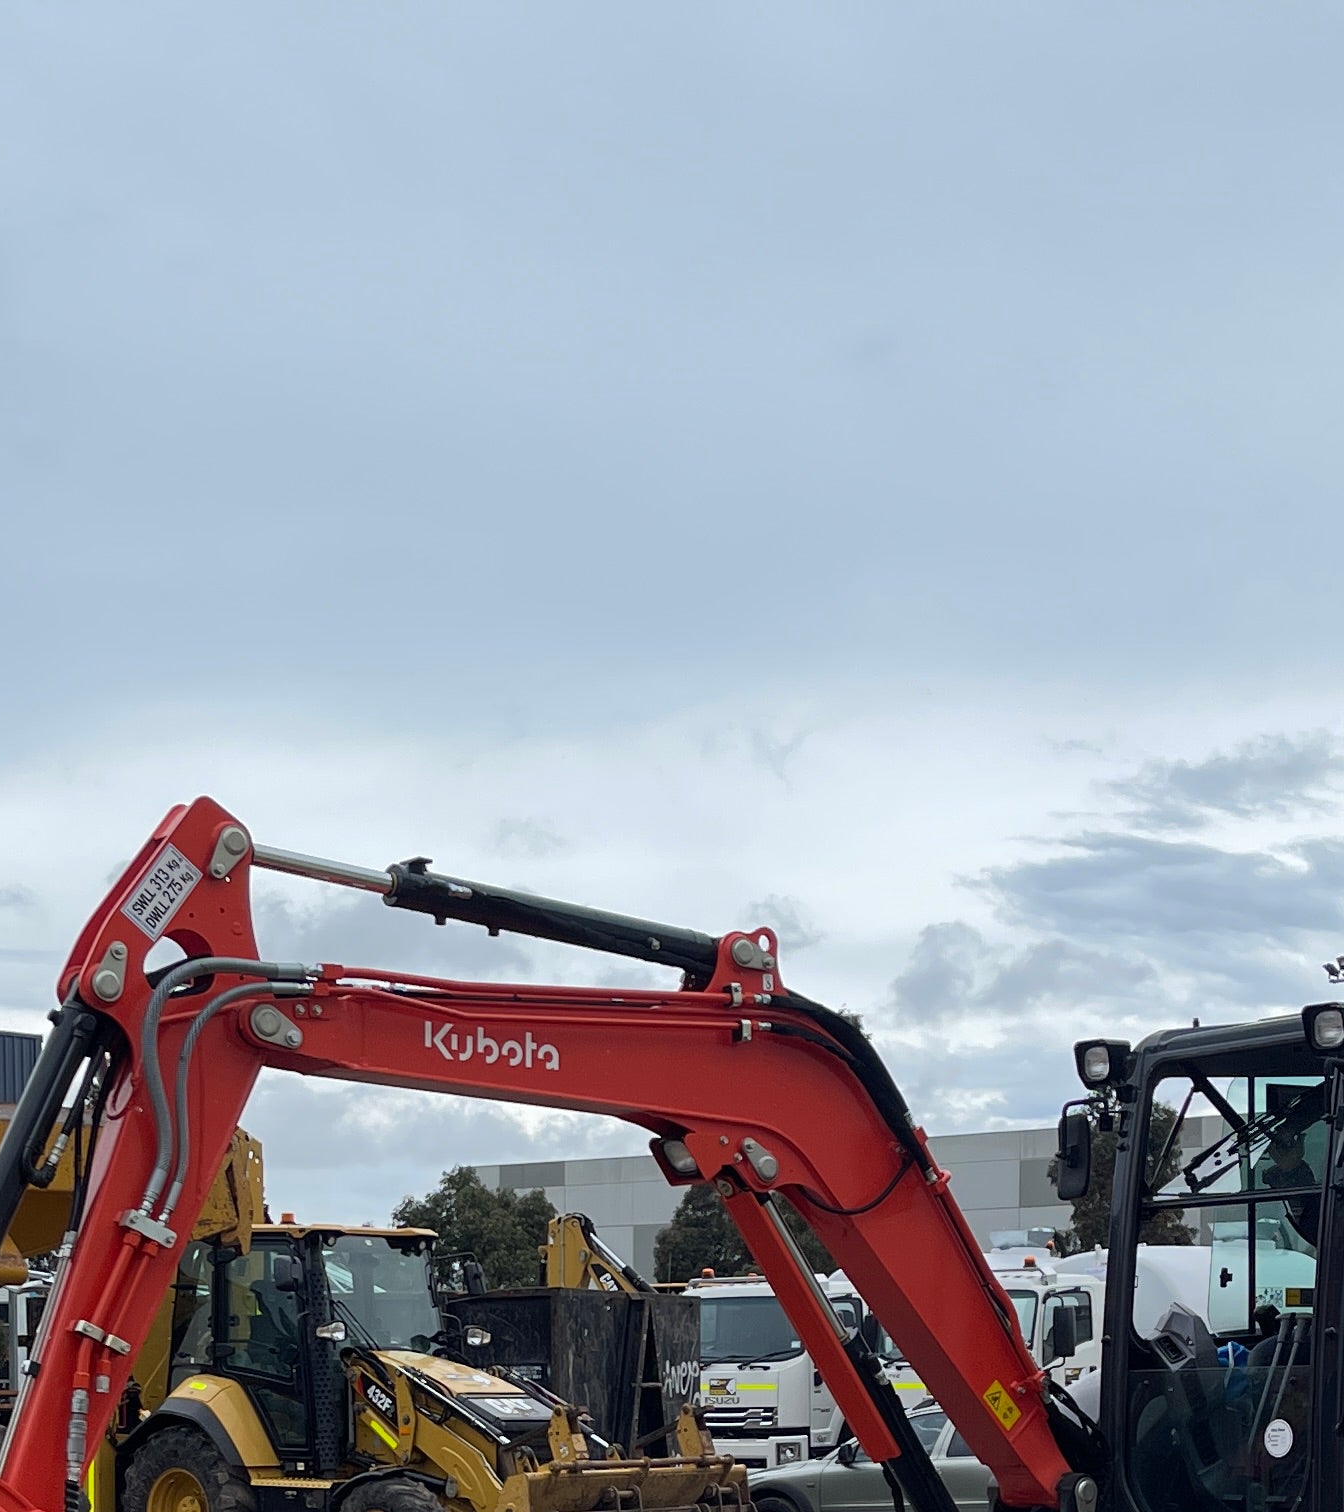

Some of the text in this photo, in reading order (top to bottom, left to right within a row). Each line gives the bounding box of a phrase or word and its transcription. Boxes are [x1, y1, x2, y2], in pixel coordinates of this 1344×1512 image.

[132, 859, 181, 916] SWLL 313 Kg
[145, 871, 194, 929] DWLL 275 Kg
[424, 1020, 560, 1071] Kubota
[704, 1396, 740, 1405] ISUZU
